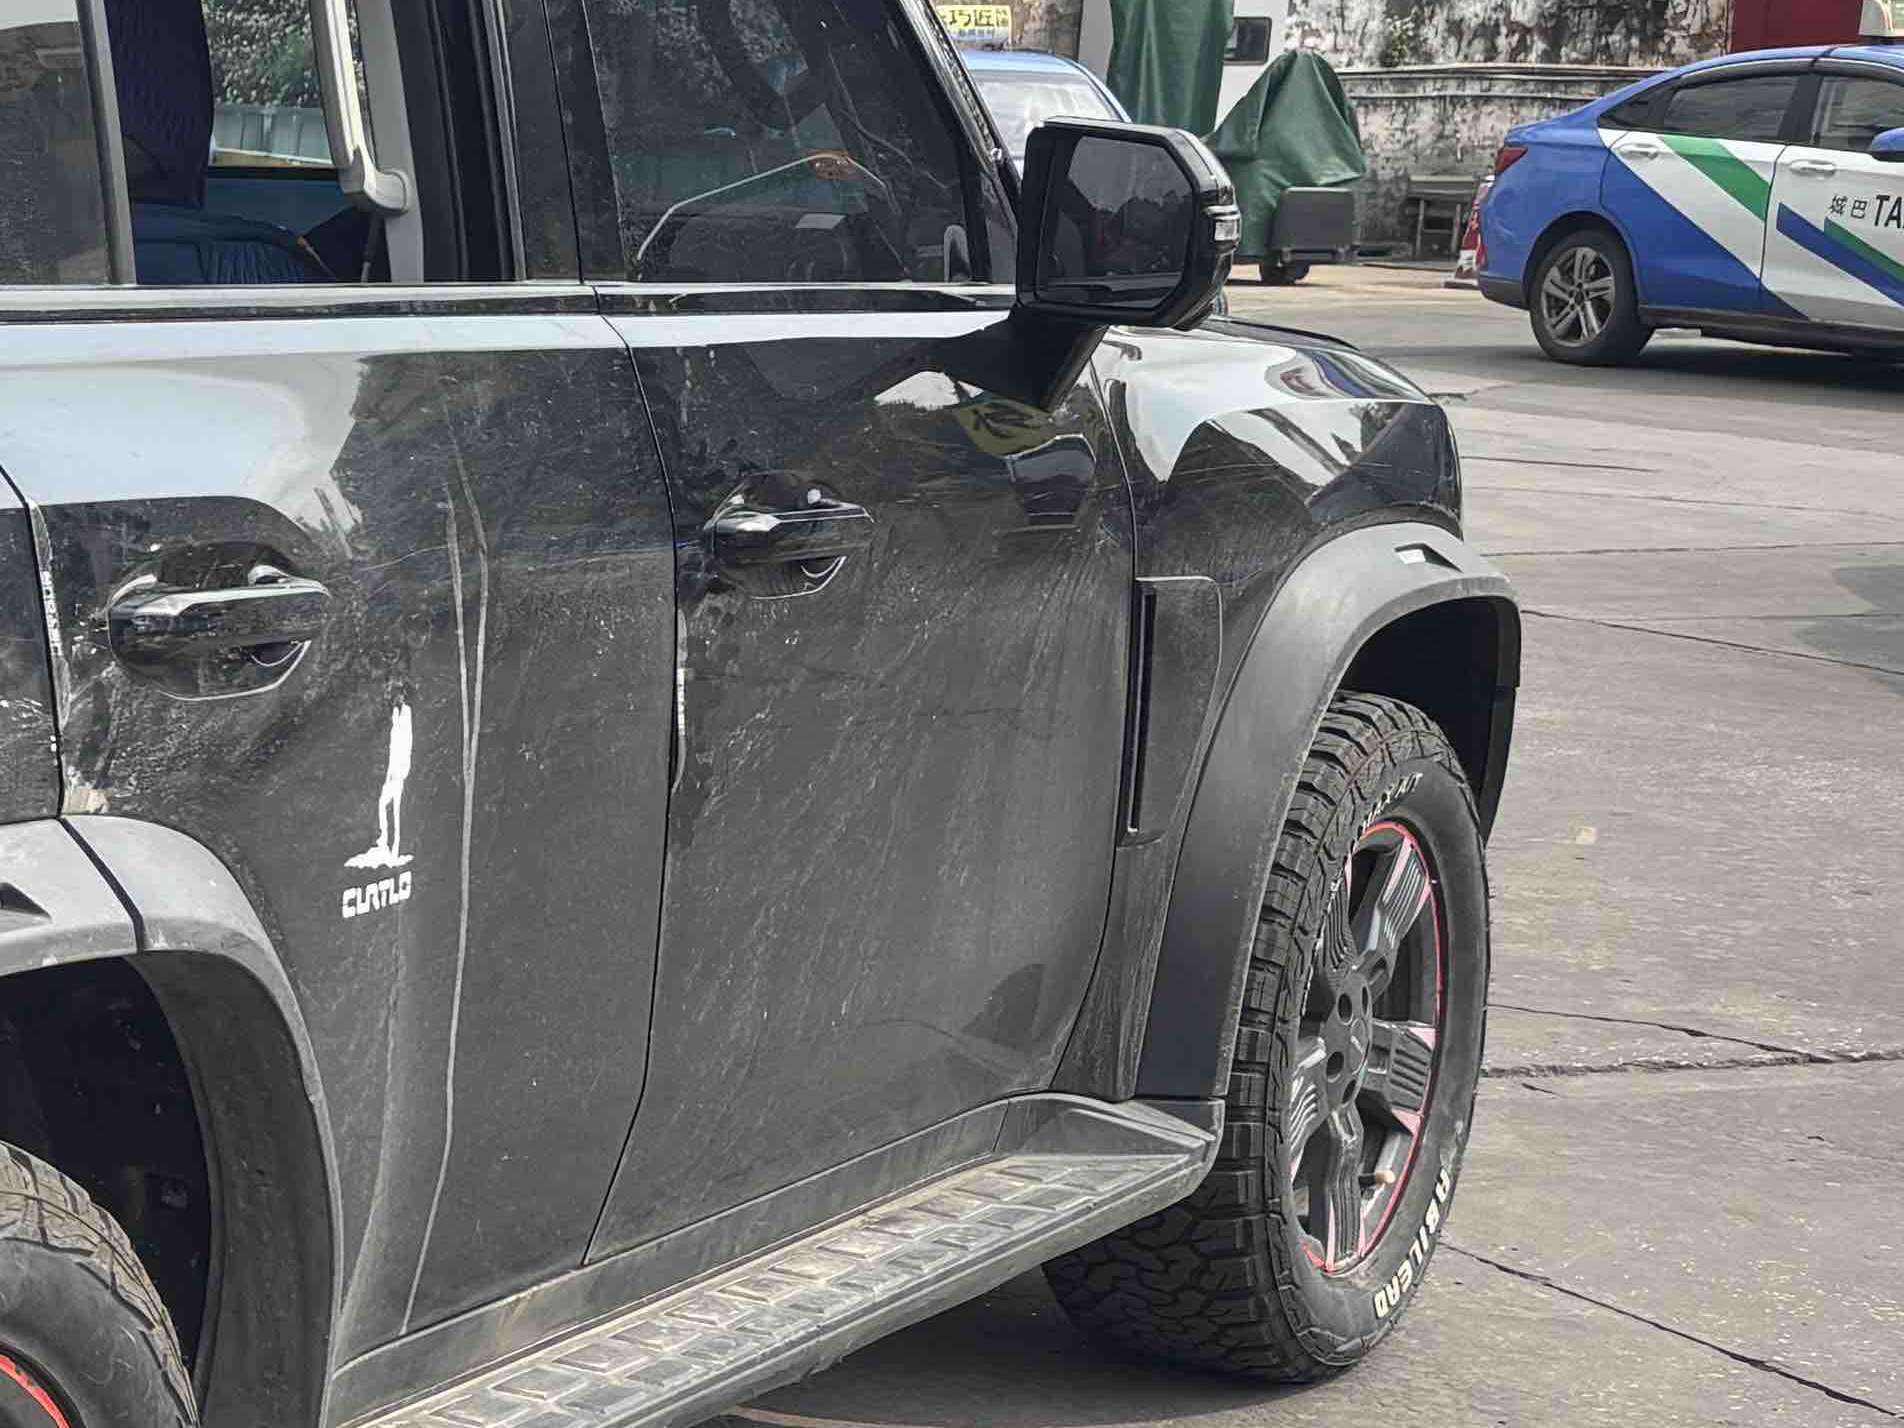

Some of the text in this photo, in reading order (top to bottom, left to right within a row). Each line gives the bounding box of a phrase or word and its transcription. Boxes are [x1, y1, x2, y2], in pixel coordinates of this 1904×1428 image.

[1829, 194, 1868, 219] 城巴
[1875, 194, 1904, 229] TA
[1374, 1168, 1451, 1319] ABILEAD
